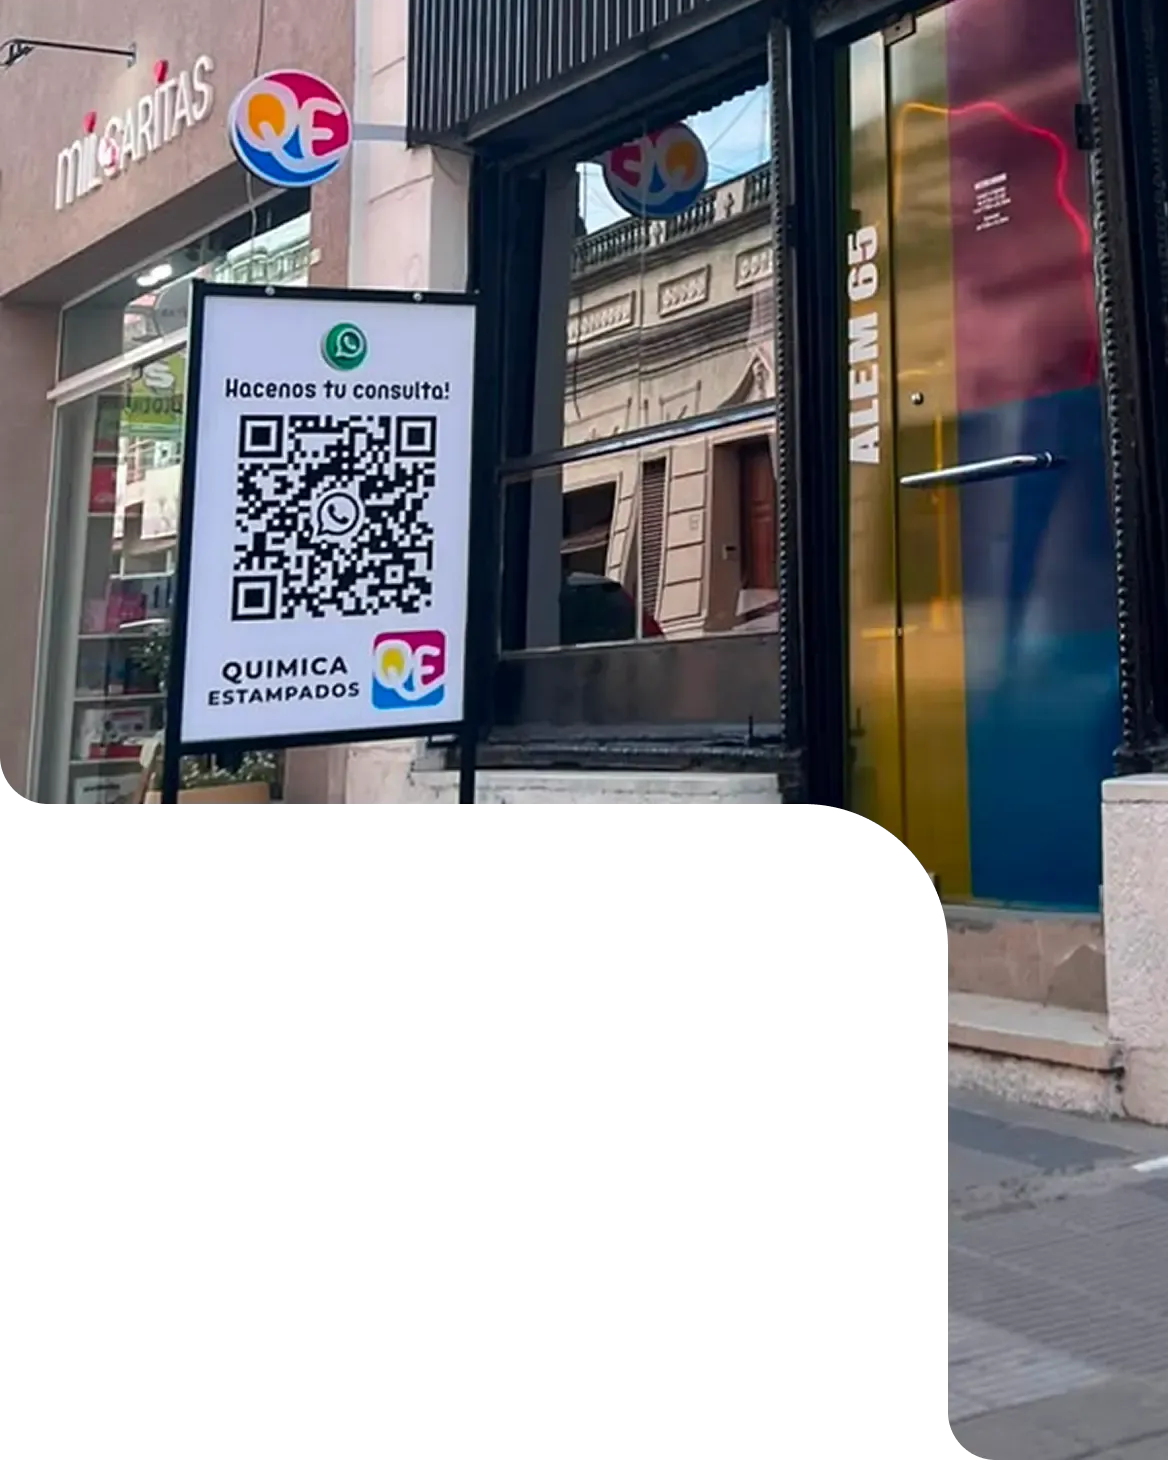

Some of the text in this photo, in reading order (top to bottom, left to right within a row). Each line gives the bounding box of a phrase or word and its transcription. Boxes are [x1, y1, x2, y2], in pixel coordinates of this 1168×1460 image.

[847, 225, 880, 464] ALEM 65
[225, 377, 450, 400] Hacenos tu consulta!
[221, 655, 348, 685] QUIMICA
[207, 681, 360, 706] ESTAMPADOS
